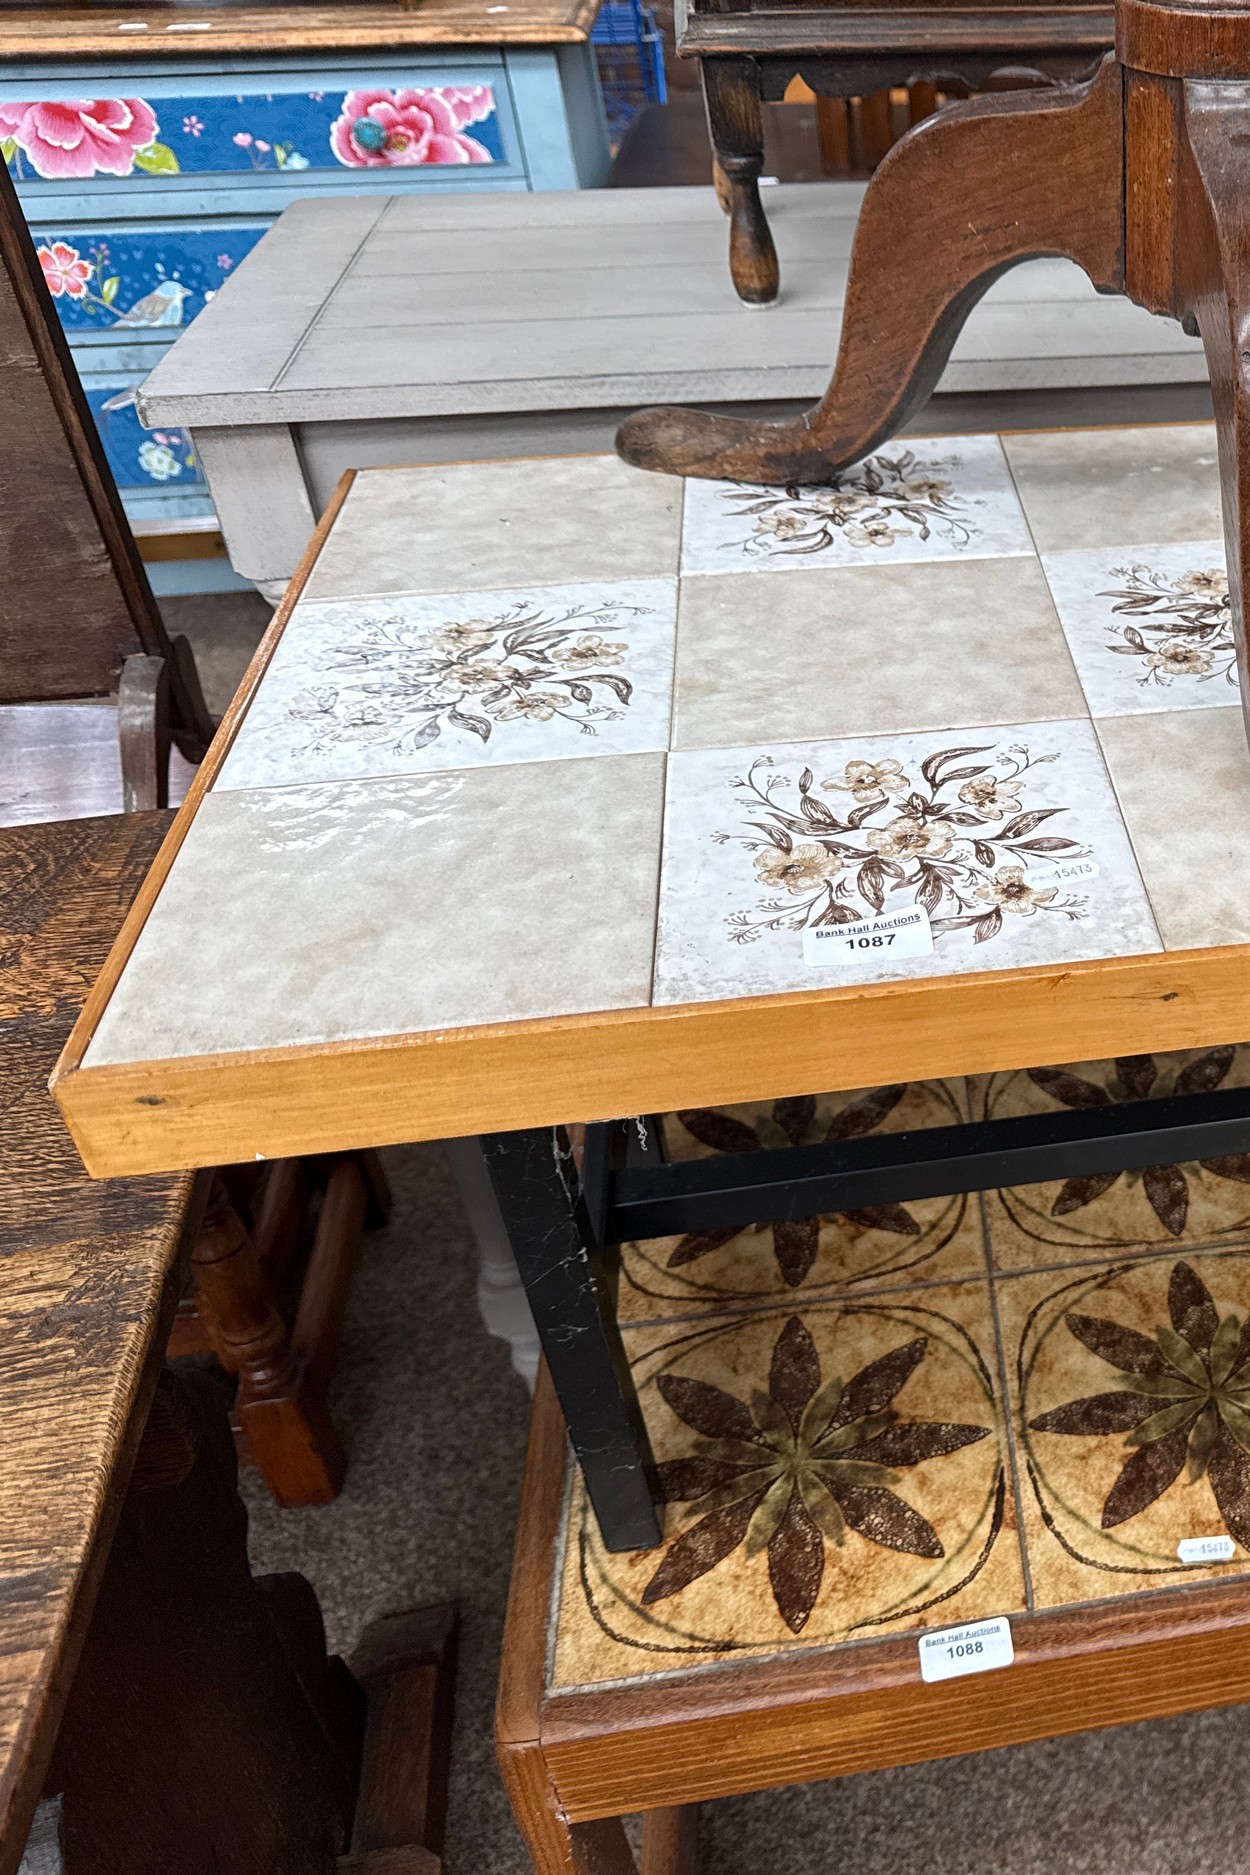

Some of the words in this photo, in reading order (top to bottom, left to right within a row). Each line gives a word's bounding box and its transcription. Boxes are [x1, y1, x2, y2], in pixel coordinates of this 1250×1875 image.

[815, 929, 845, 938] Bank
[848, 924, 870, 934] Hall
[873, 913, 921, 930] Auctions
[845, 934, 897, 950] 1087
[925, 1637, 946, 1647] Bank
[948, 1632, 964, 1643] Hall
[965, 1625, 1001, 1639] Auctions
[947, 1641, 984, 1659] 1088
